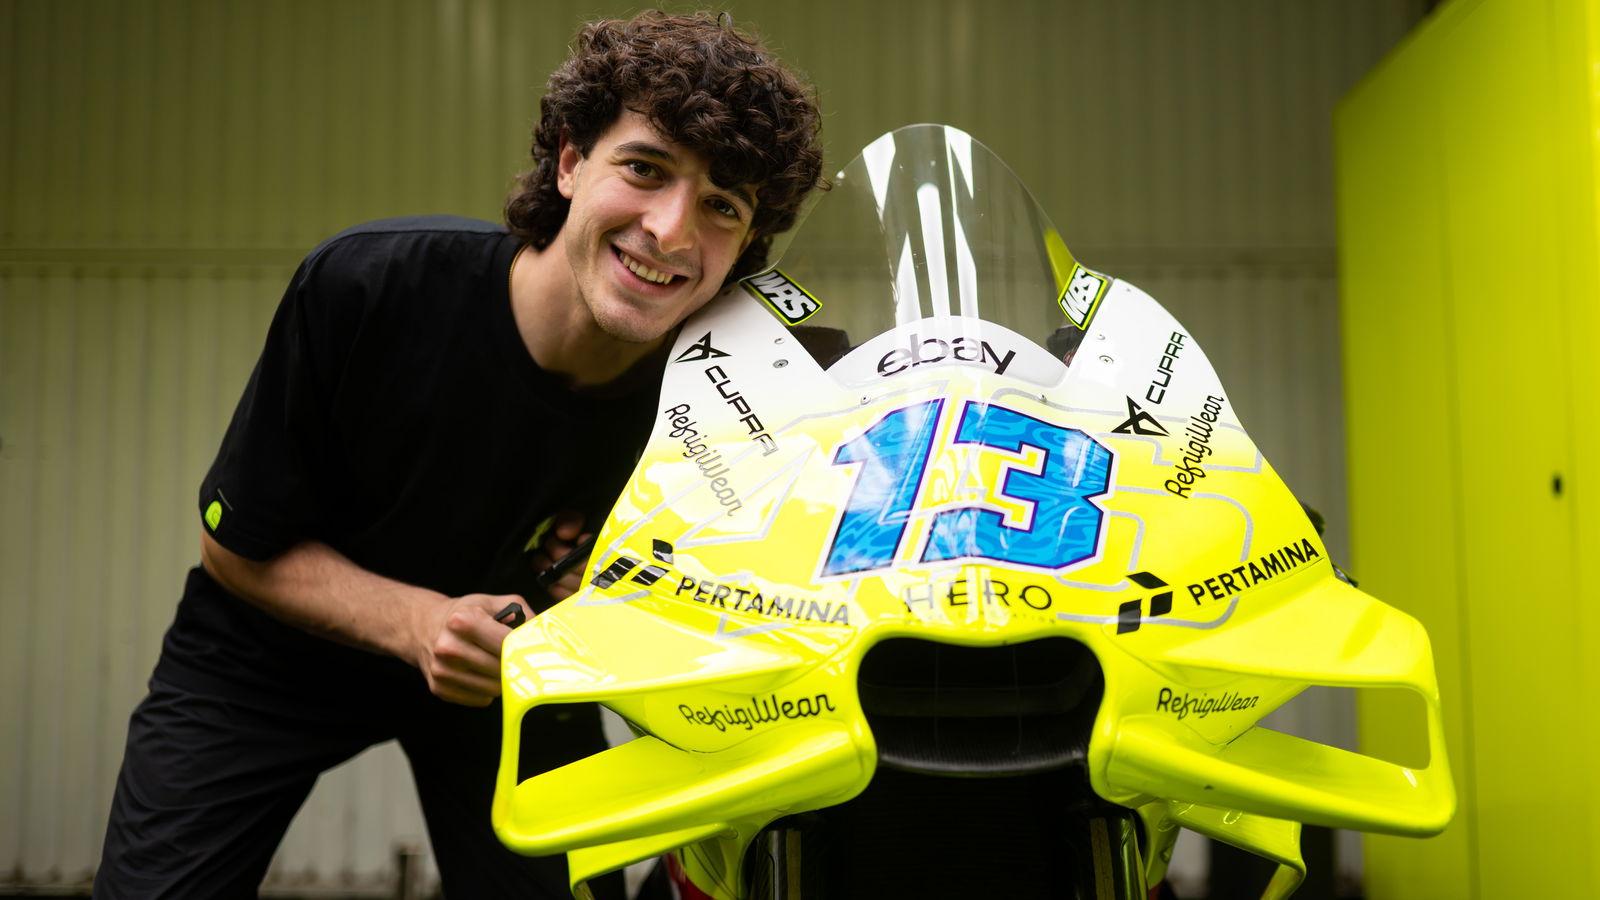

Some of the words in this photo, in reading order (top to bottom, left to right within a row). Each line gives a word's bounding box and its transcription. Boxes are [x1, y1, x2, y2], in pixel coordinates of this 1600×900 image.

[750, 270, 818, 319] WRS
[877, 333, 1016, 378] ebay
[1146, 331, 1187, 405] CUPRA
[704, 365, 779, 457] CUPRA
[664, 403, 742, 517] RefrigiWear
[1164, 395, 1225, 499] RefrigiWear
[817, 397, 1115, 571] 13
[675, 576, 850, 626] PERTAMINA
[904, 579, 1052, 613] HERO
[1187, 538, 1320, 605] PERTAMINA
